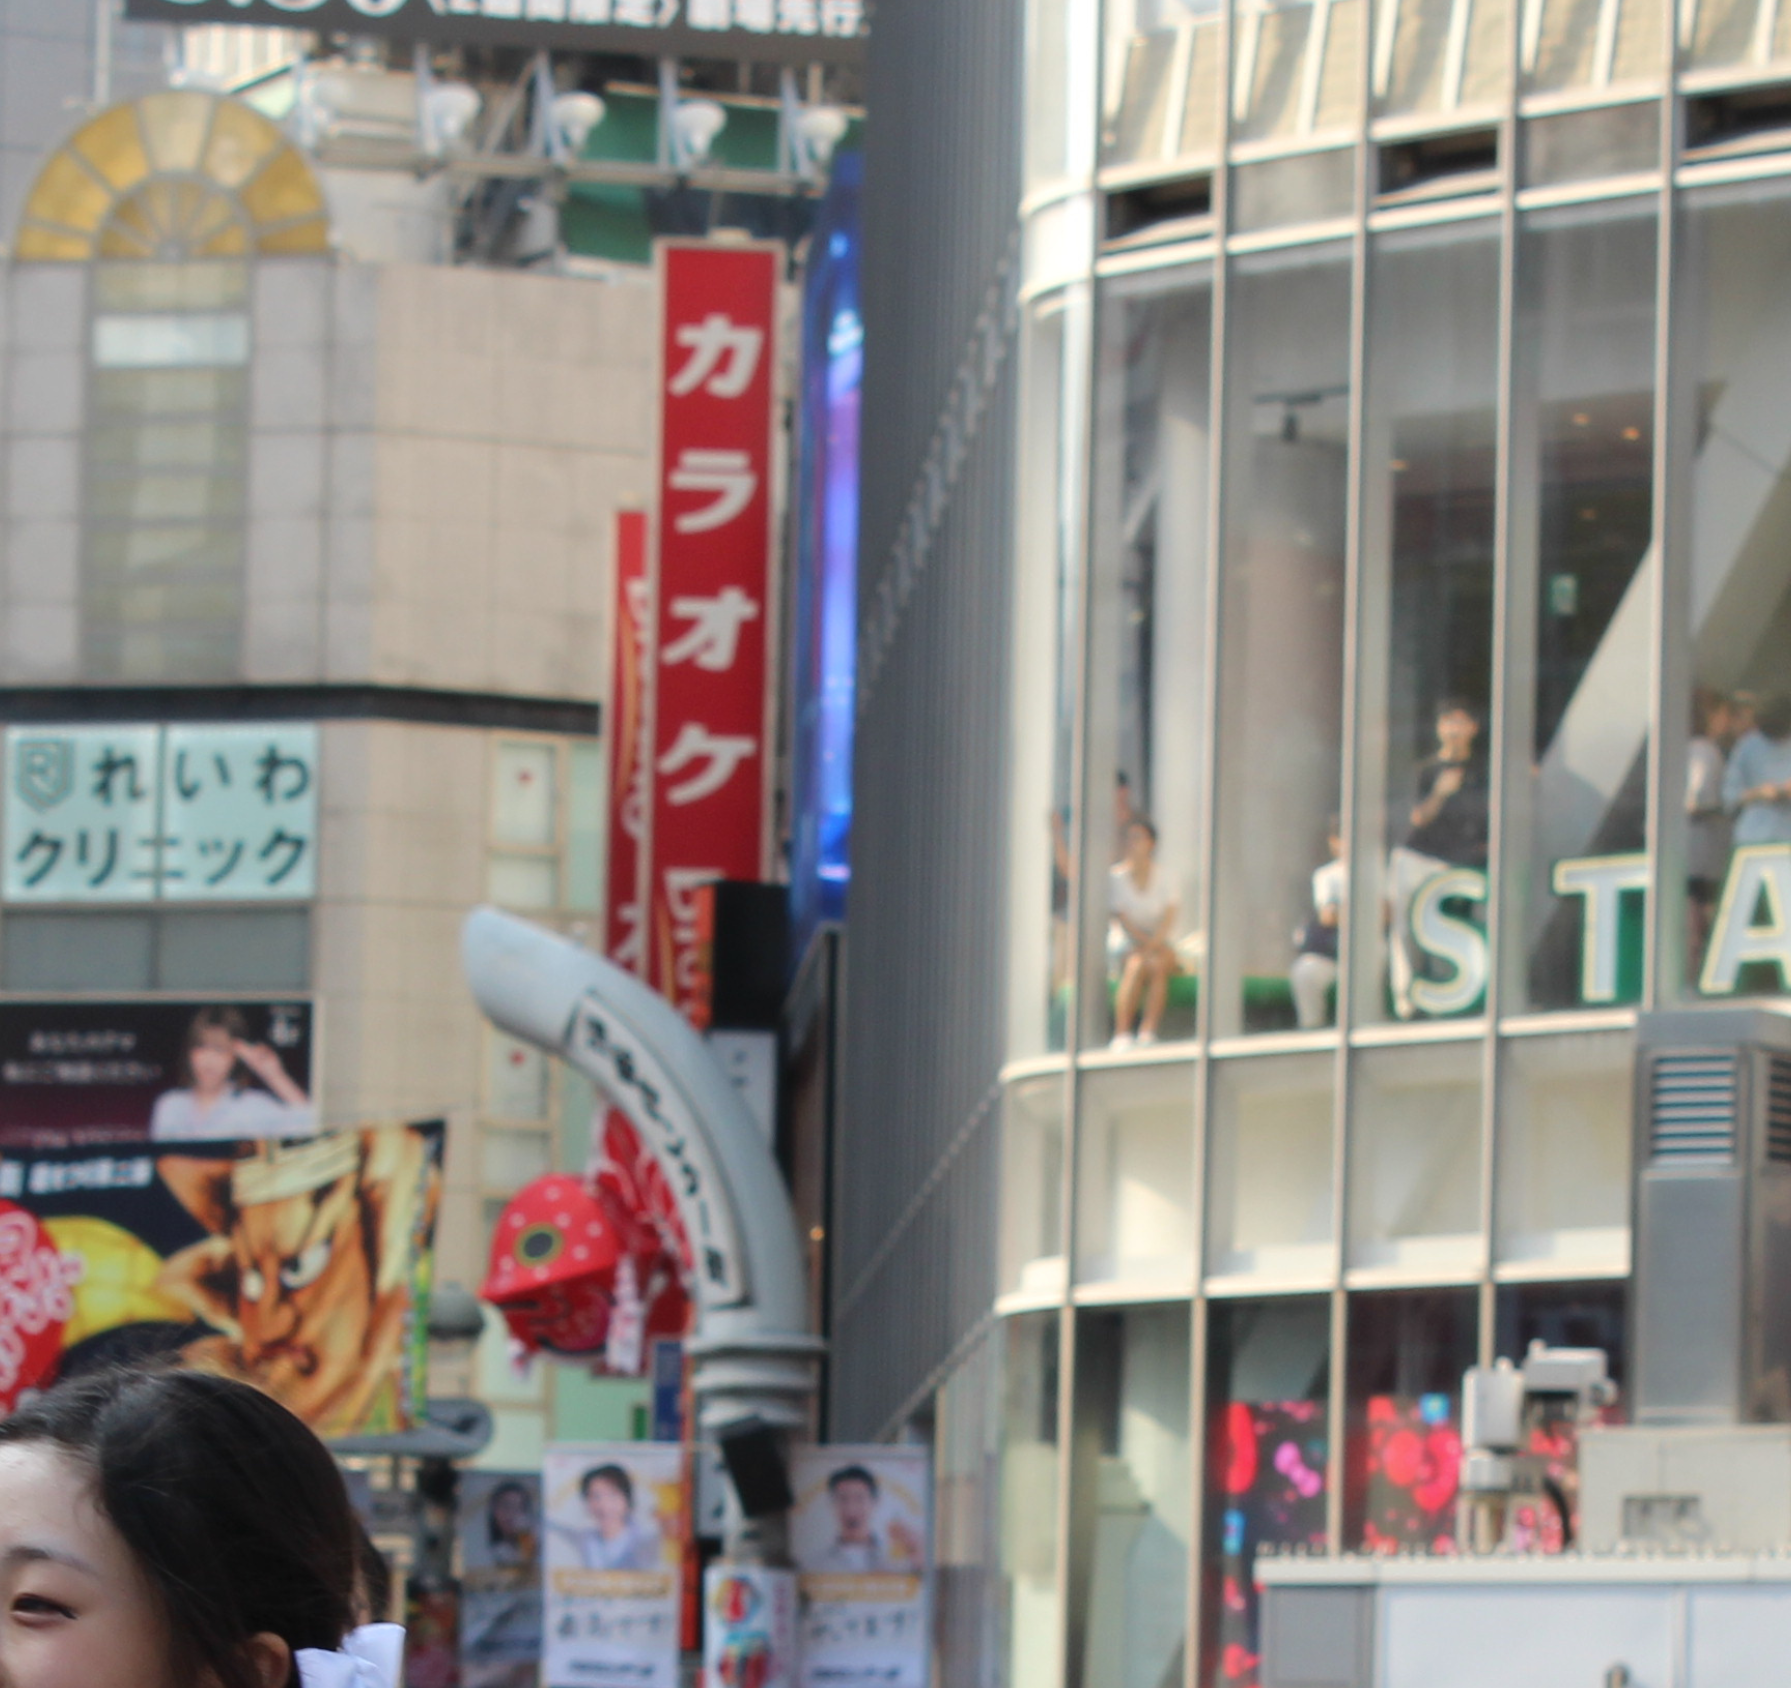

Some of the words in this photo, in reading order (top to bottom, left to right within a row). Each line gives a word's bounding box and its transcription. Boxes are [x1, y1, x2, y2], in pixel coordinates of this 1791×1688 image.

[659, 313, 765, 806] カラオケ
[91, 745, 311, 803] れいわ
[15, 828, 307, 888] クリニック
